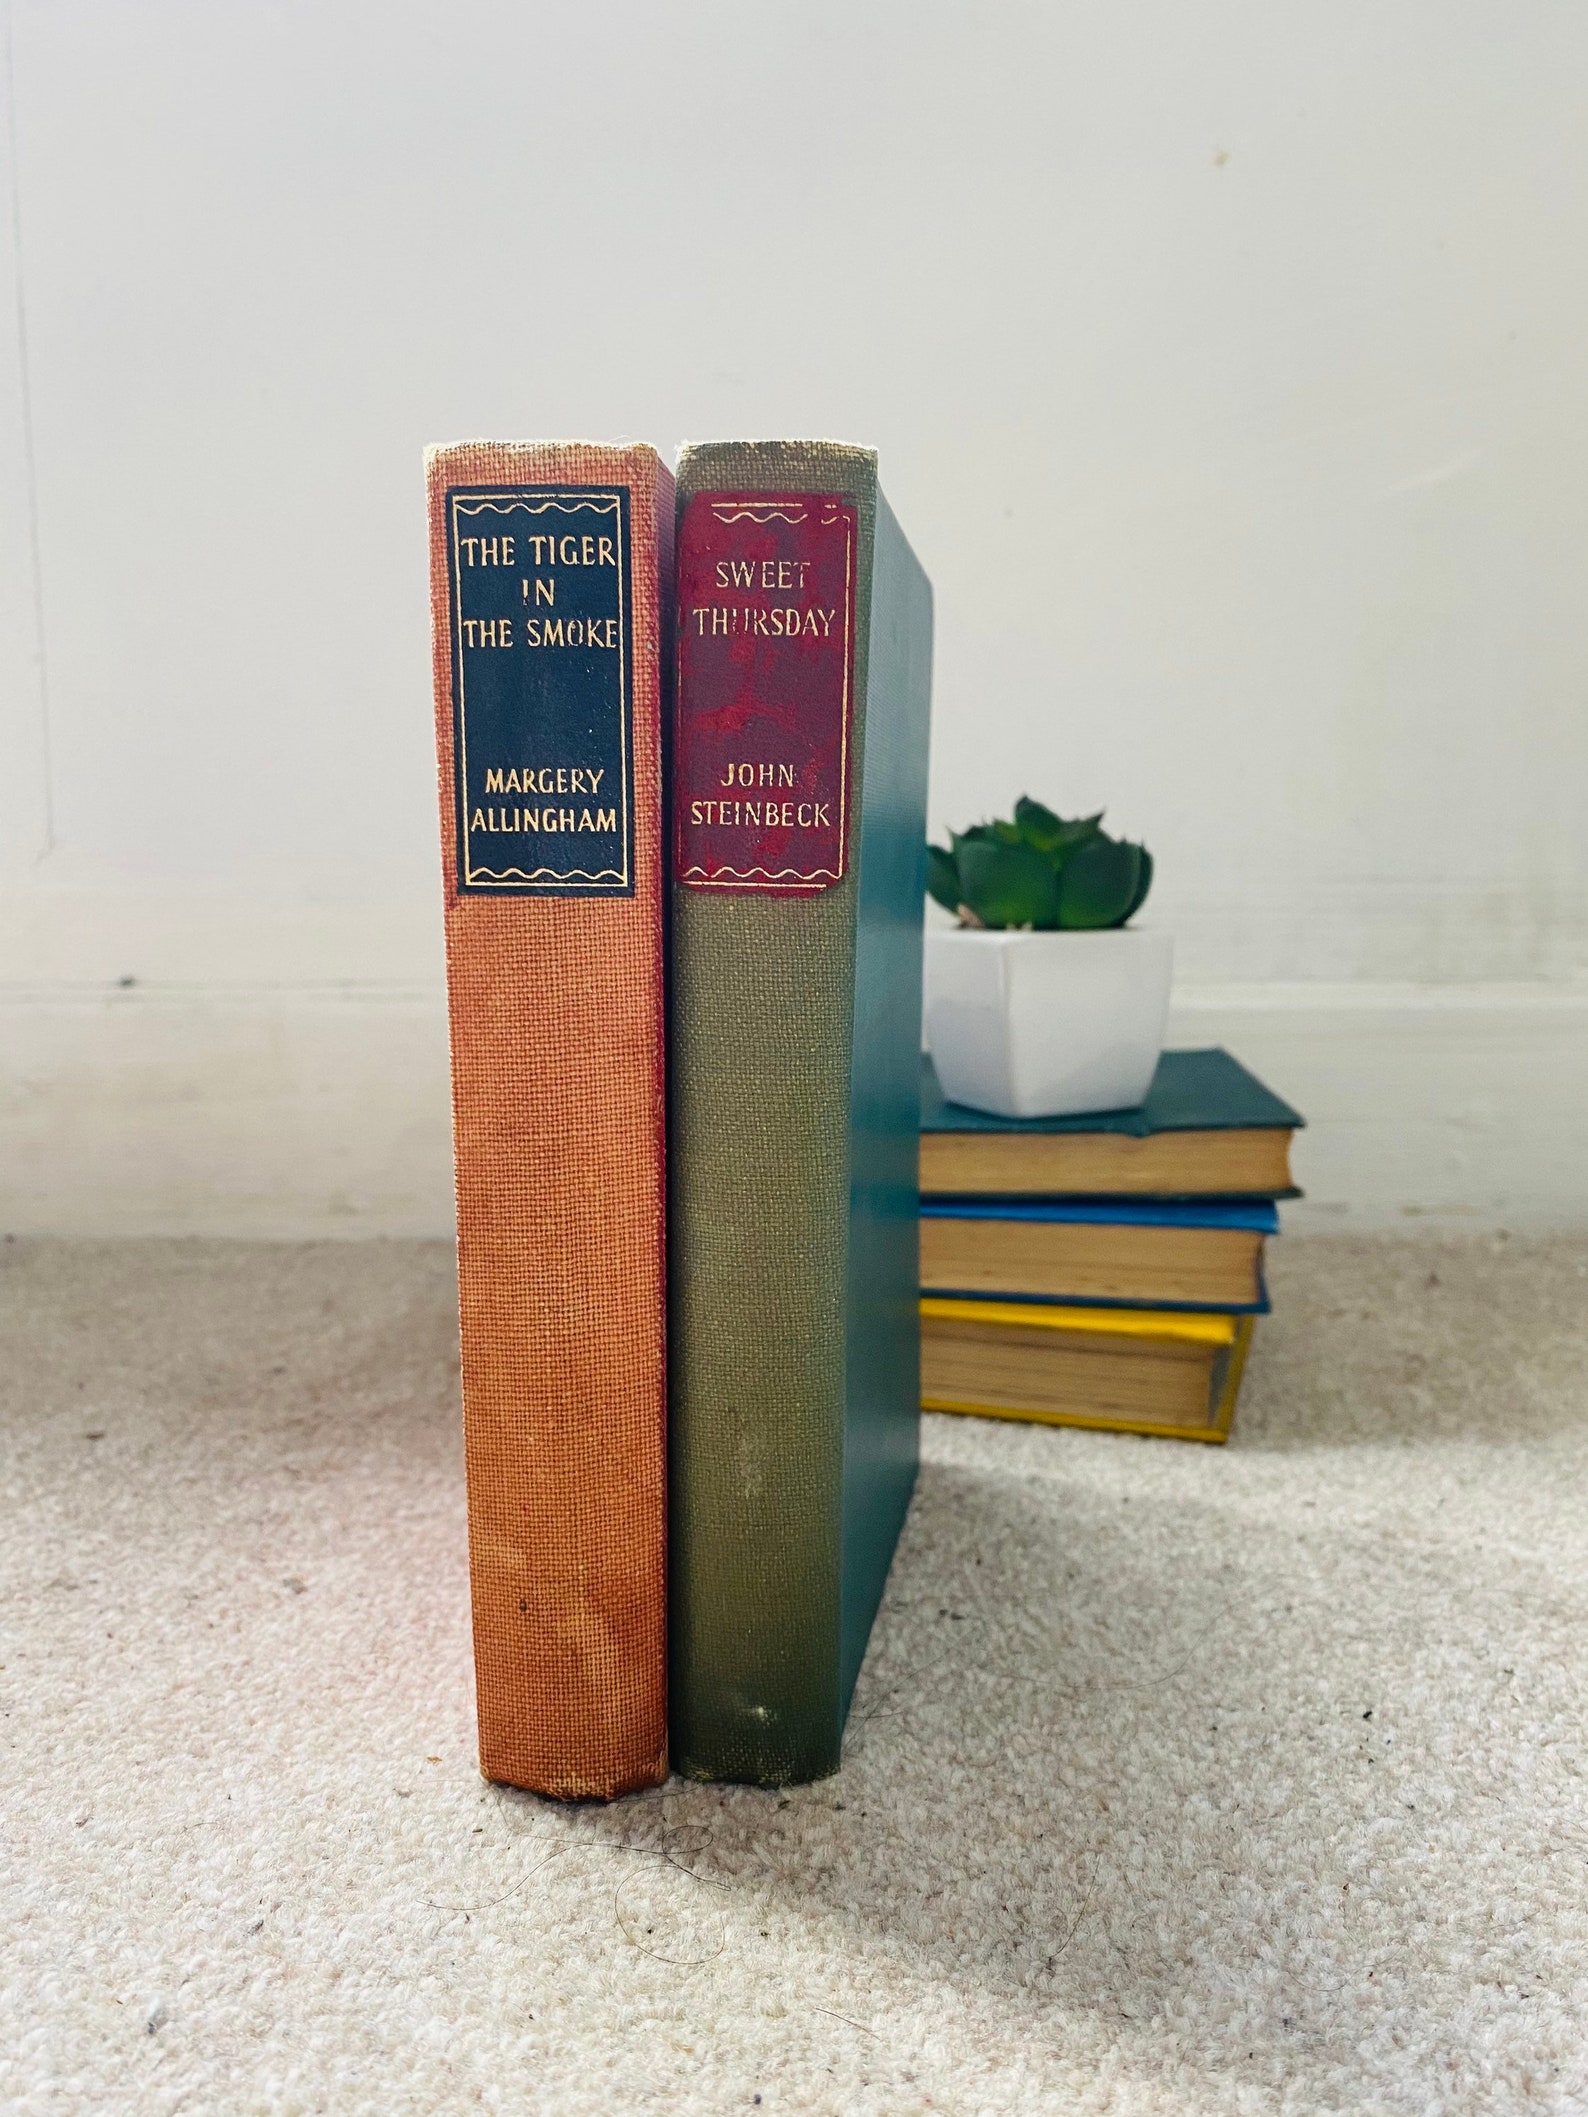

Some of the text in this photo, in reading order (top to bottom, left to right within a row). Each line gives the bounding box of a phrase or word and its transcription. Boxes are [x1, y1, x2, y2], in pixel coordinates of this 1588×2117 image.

[461, 536, 617, 567] THE TIGER
[715, 561, 811, 589] SWEET
[522, 578, 555, 607] IN
[463, 618, 618, 649] THE SMOKE
[485, 768, 605, 794] MARGERY
[721, 763, 795, 788] JOHN
[471, 808, 617, 833] ALLINGHAM
[690, 801, 831, 828] STEINBECK
